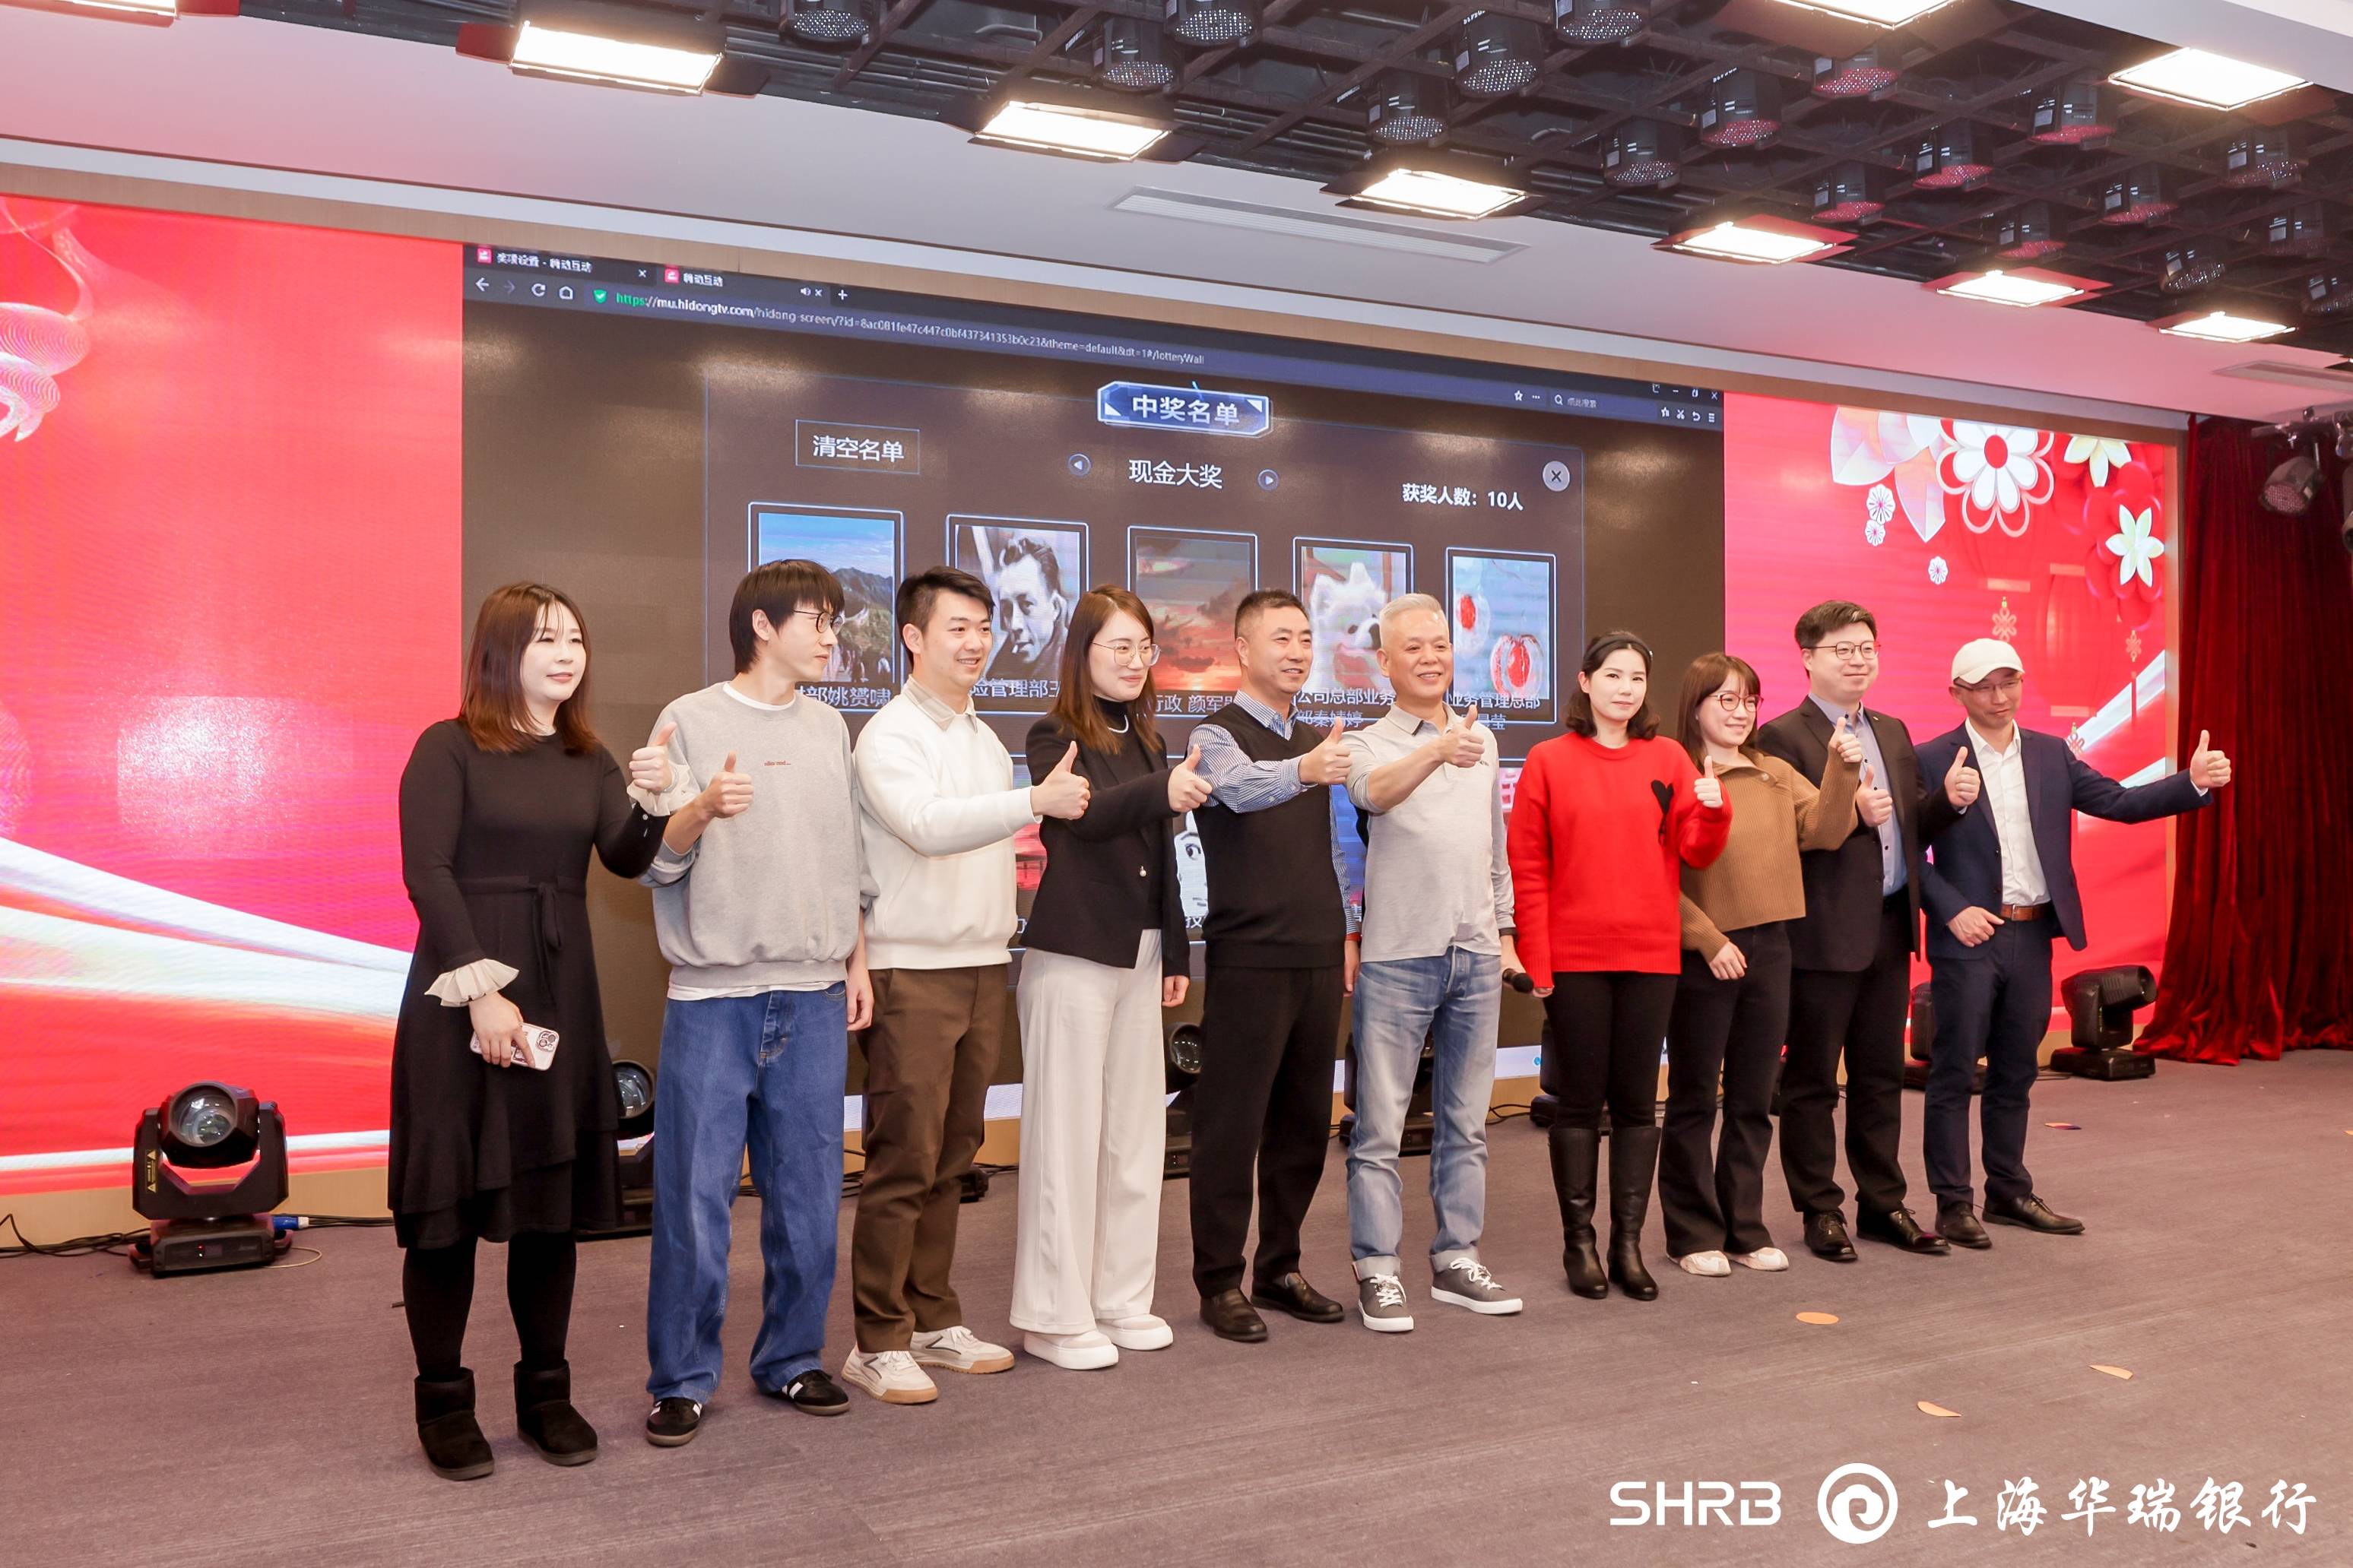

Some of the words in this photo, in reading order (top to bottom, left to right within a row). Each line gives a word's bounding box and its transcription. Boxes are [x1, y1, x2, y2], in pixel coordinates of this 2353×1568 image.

[1131, 394, 1239, 426] 中奖名单
[812, 434, 905, 463] 清空名单
[1128, 459, 1223, 489] 现金大奖
